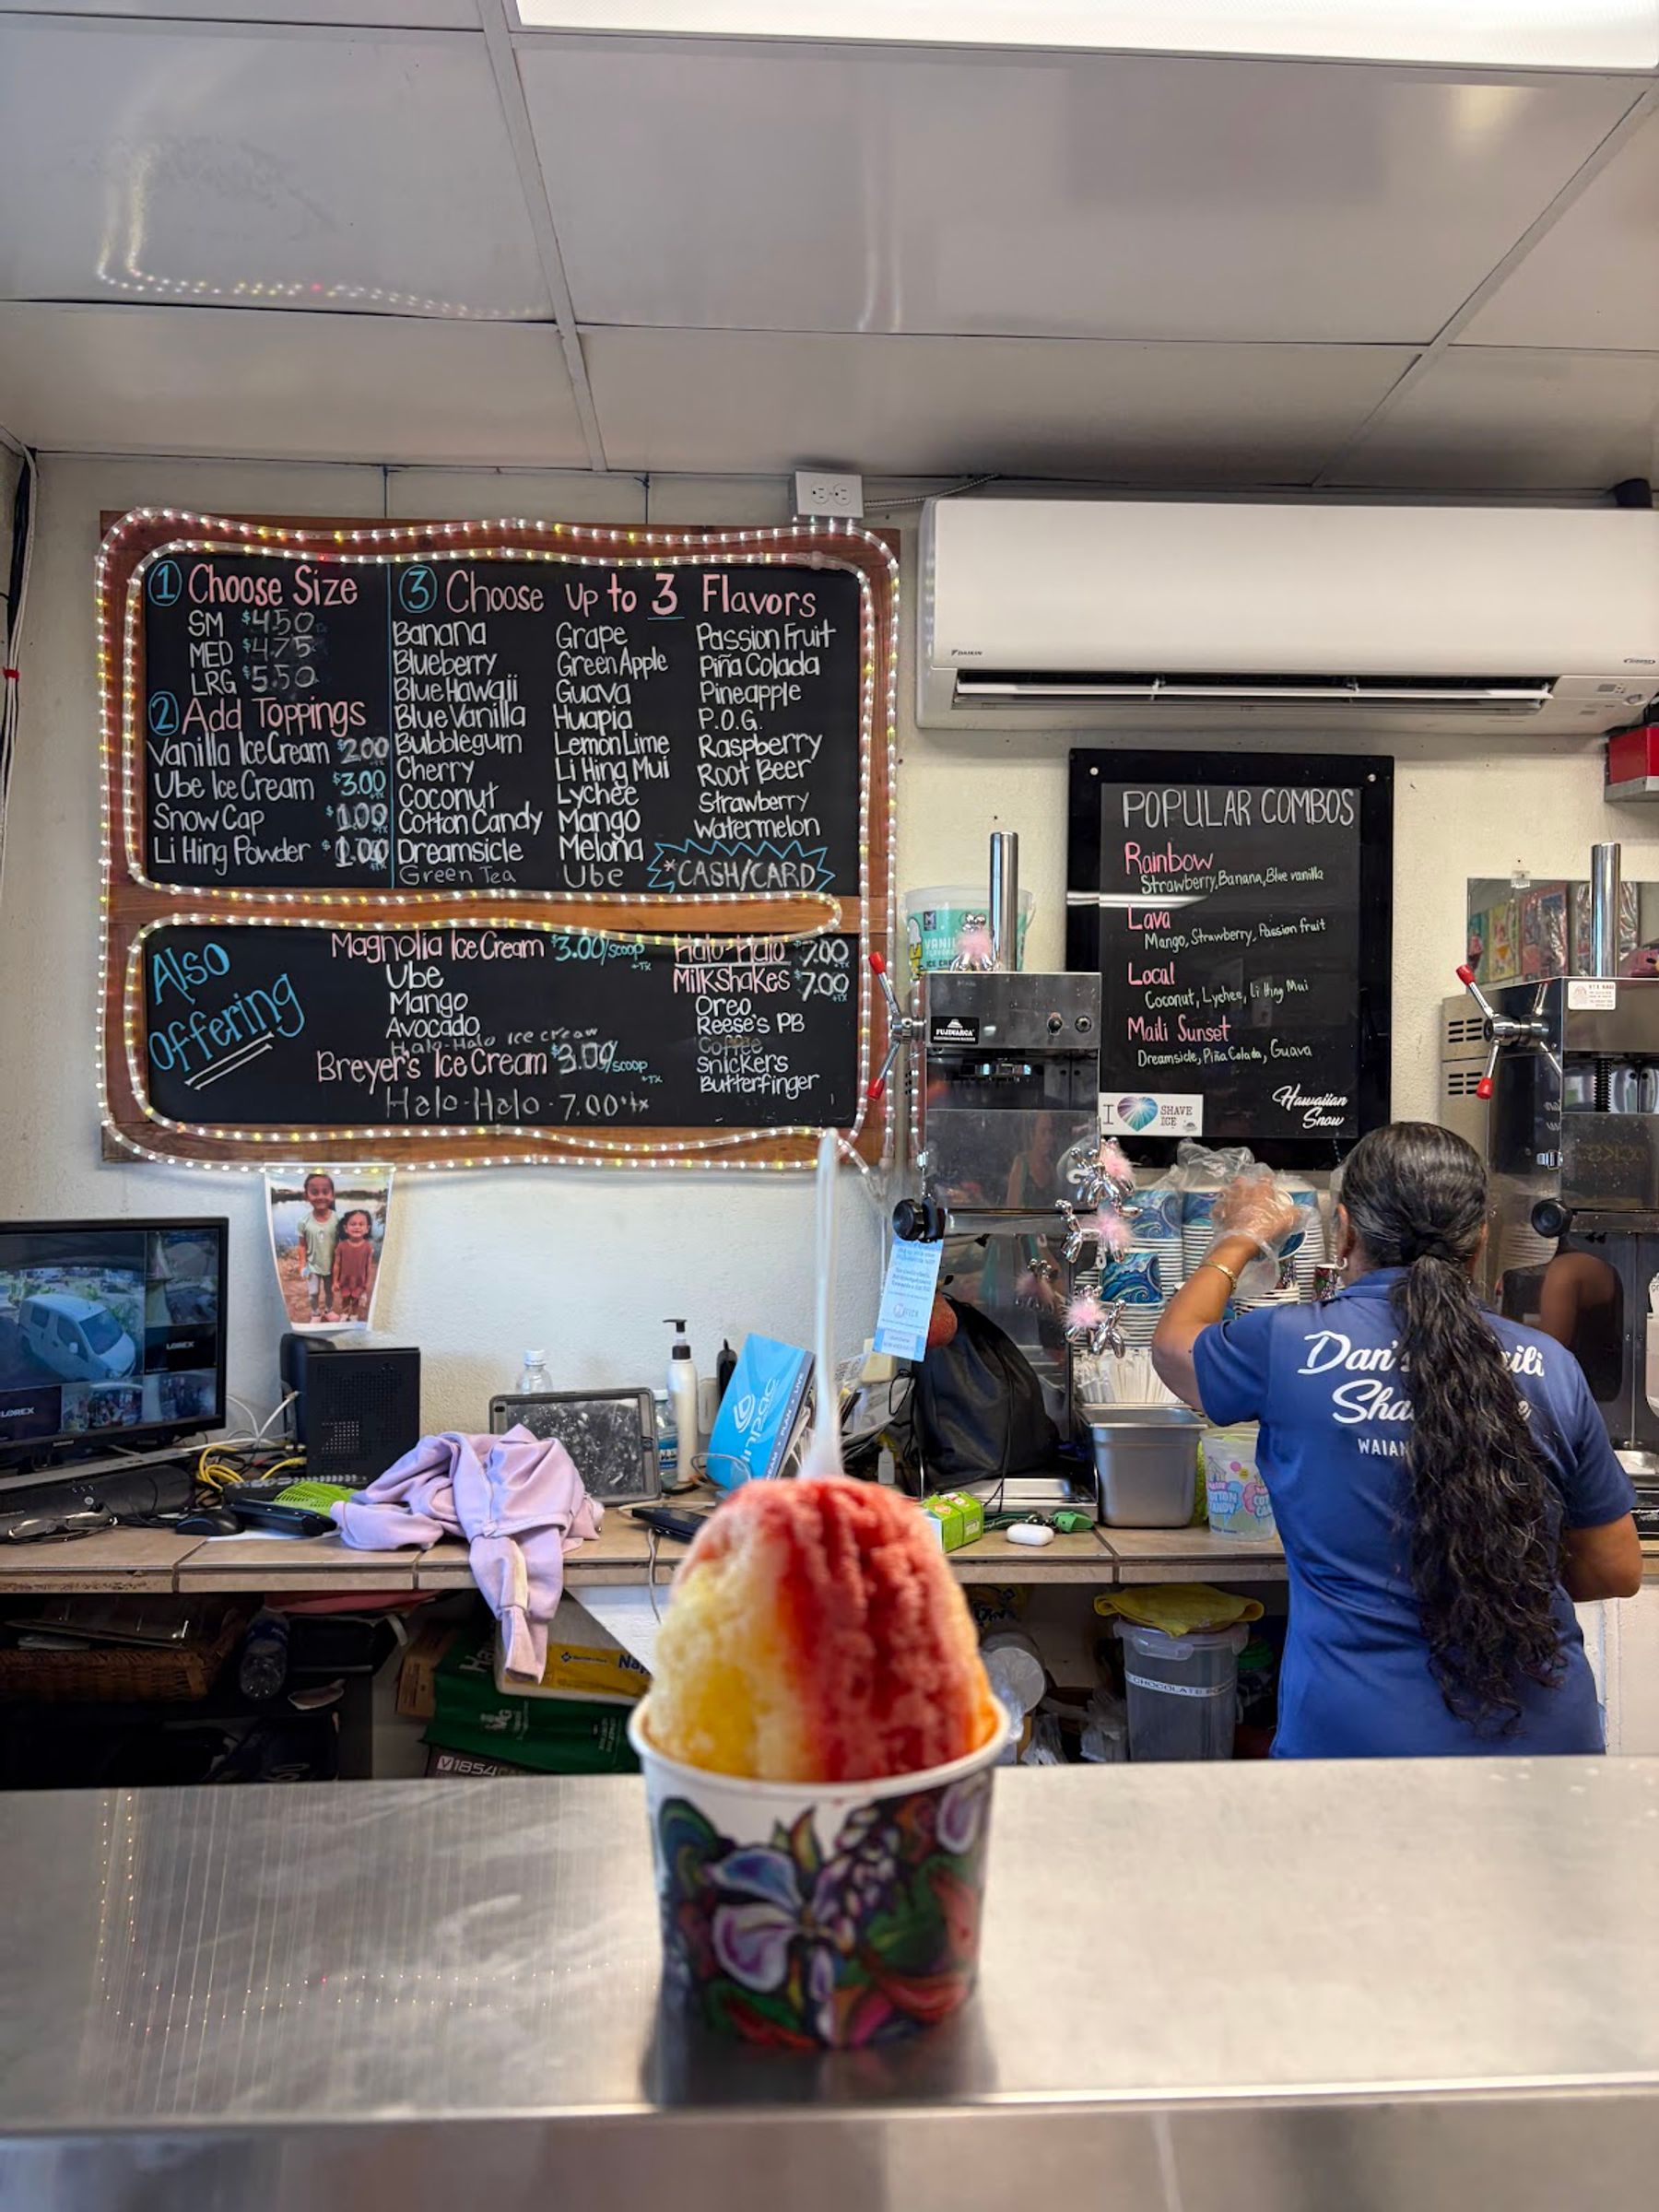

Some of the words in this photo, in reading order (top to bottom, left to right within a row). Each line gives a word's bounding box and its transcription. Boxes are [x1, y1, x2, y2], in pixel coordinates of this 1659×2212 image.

[188, 563, 283, 606] Choose
[292, 564, 358, 606] Size
[446, 570, 544, 613] Choose
[565, 582, 599, 618] Up
[606, 572, 637, 613] to
[652, 572, 678, 616] 3
[702, 573, 817, 618] Flavors
[188, 609, 224, 637] SM
[393, 620, 487, 647] Banana
[696, 621, 780, 652] Passion
[784, 618, 837, 650] Fruit
[556, 621, 629, 654] Grape
[189, 641, 234, 668] MED
[393, 648, 498, 677] Blueberry
[557, 651, 618, 677] Green
[619, 645, 668, 680] Apple
[700, 653, 743, 678] Piña
[746, 650, 820, 679] Colada
[191, 668, 237, 696] LRG
[394, 677, 444, 702] Blue
[446, 674, 518, 702] Hawaii
[556, 678, 631, 704] Guava
[700, 680, 802, 711] Pineapple
[182, 698, 241, 735] Add
[251, 696, 367, 737] Toppings
[394, 703, 448, 730] Blue
[450, 700, 526, 730] Vanilla
[698, 707, 763, 731] P.O.G.
[147, 731, 230, 767] Vanilla
[395, 730, 523, 756] Bubblegum
[554, 731, 621, 756] Lemon
[622, 730, 670, 755] Lime
[699, 733, 823, 762] Raspberry
[396, 755, 475, 783] Cherry
[555, 757, 576, 782] Li
[581, 757, 628, 789] Hing
[632, 756, 670, 782] Mui
[697, 759, 750, 787] Root
[756, 759, 813, 784] Beer
[154, 770, 205, 799] Ube
[212, 770, 238, 800] Ice
[241, 769, 315, 801] Cream
[333, 770, 387, 796] $3.00
[398, 782, 500, 811] Coconut
[557, 782, 640, 809] Lychee
[699, 790, 810, 814] Strawberry
[1123, 789, 1252, 828] POPULAR
[1261, 788, 1354, 827] COMBOS
[153, 802, 219, 831] Snow
[222, 804, 265, 837] Cap
[399, 808, 469, 835] Cotton
[472, 800, 543, 835] Candy
[558, 808, 641, 840] Mango
[694, 815, 820, 840] Watermelon
[154, 836, 176, 864] Li
[182, 835, 228, 876] Hing
[234, 834, 312, 865] Powder
[397, 837, 524, 865] Dreamsicle
[559, 832, 643, 862] Melona
[1124, 841, 1214, 875] Rainbow
[399, 865, 474, 885] Green
[479, 865, 516, 884] Tea
[563, 863, 623, 888] Ube
[1128, 904, 1171, 930] Lava
[332, 930, 442, 963] Magnolia
[452, 930, 478, 960] Ice
[480, 931, 544, 960] Cream
[153, 942, 230, 1006] Also
[386, 960, 444, 989] Ube
[1128, 961, 1175, 985] Local
[390, 991, 468, 1018] Mango
[696, 995, 751, 1016] Oreo
[385, 1014, 480, 1039] Avocado
[697, 1014, 770, 1035] Reese's
[777, 1013, 805, 1033] PB
[1127, 1017, 1169, 1041] Maili
[1177, 1014, 1231, 1042] Sunset
[1270, 1038, 1312, 1059] Guava
[317, 1049, 421, 1095] Breyer's
[435, 1047, 467, 1078] Ice
[471, 1048, 547, 1076] Cream
[697, 1053, 789, 1074] Snickers
[700, 1074, 820, 1100] Butterfinger
[1272, 1083, 1348, 1111] Hawaiian
[1102, 1104, 1114, 1125] I
[1160, 1105, 1193, 1116] SHAVE
[1160, 1116, 1177, 1126] ICE
[1301, 1107, 1345, 1129] Snow
[166, 1341, 194, 1350] LOREX
[0, 1407, 36, 1418] LOREX
